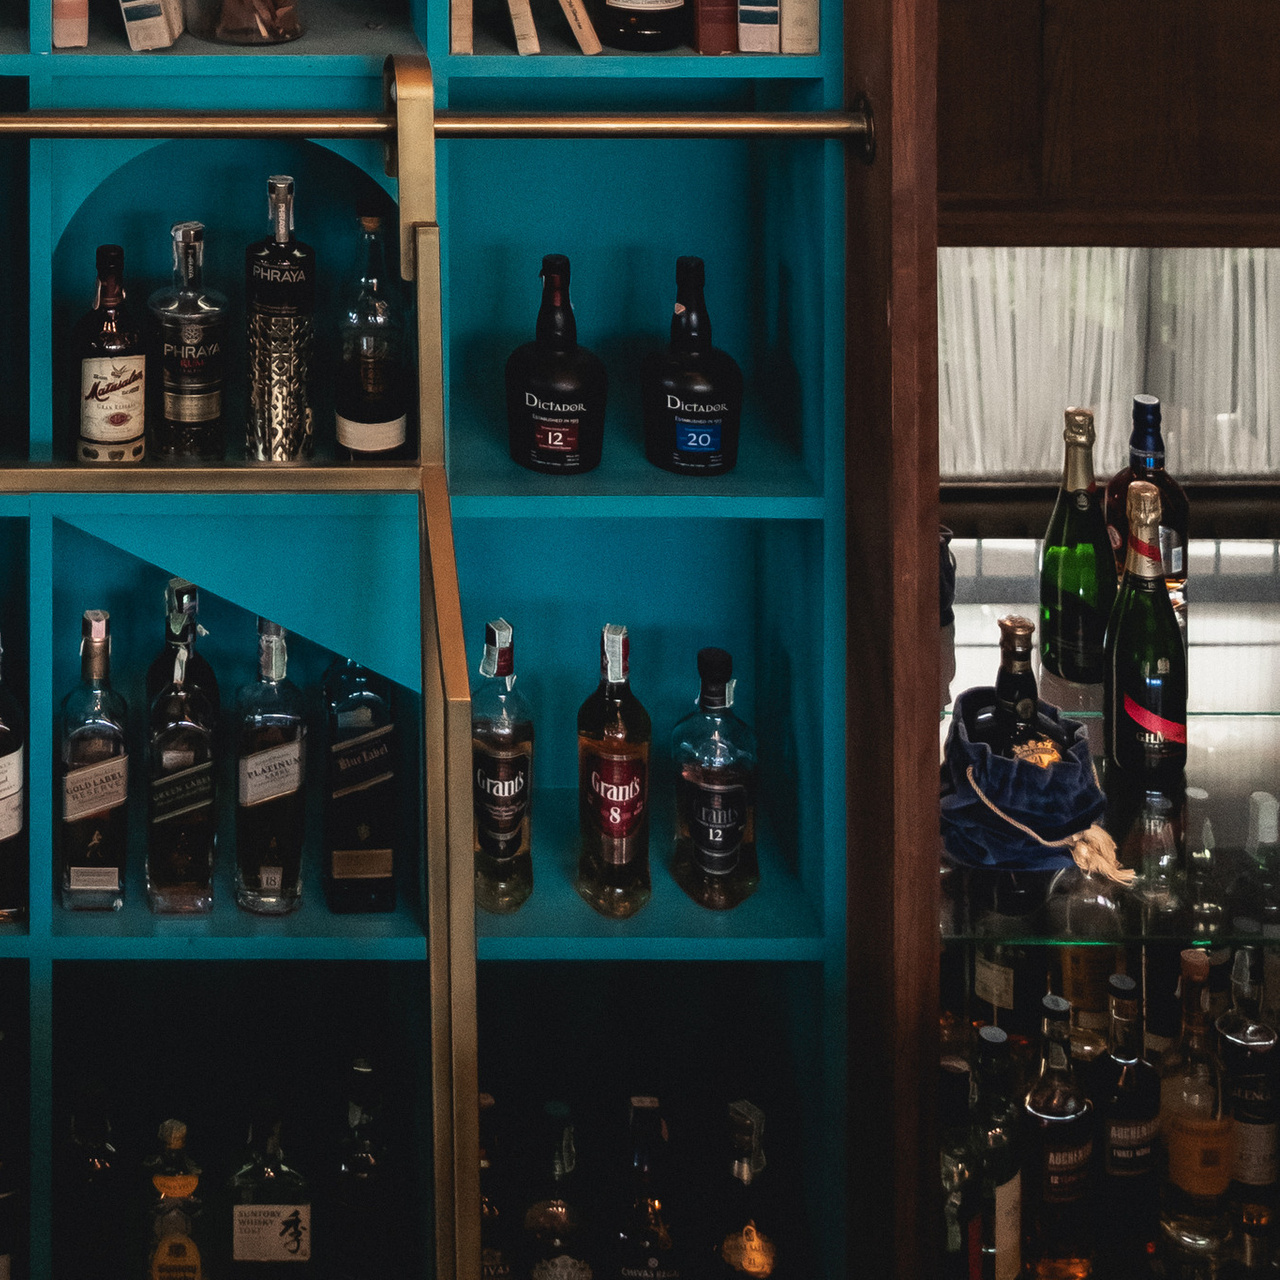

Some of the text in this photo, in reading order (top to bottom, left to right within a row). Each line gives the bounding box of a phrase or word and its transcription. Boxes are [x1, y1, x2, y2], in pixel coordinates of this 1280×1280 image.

[278, 203, 286, 234] PHRAYA
[253, 265, 306, 283] PHRAYA
[163, 343, 220, 358] PHRAYA
[180, 359, 205, 368] RUM
[525, 392, 587, 412] DICTADOR
[667, 395, 729, 413] DICTADOR
[547, 432, 564, 446] 12
[687, 432, 711, 446] 20
[247, 756, 303, 780] PLATINUM
[92, 772, 124, 788] LABEL
[477, 767, 524, 798] Grant's
[591, 771, 640, 802] Grant's
[71, 781, 123, 802] RESERVE
[609, 806, 621, 824] 8
[709, 828, 723, 841] 12
[265, 876, 276, 887] 18
[238, 1210, 281, 1218] SUNTORY
[238, 1218, 275, 1226] WHISKY
[621, 1267, 654, 1278] CHIVAS
